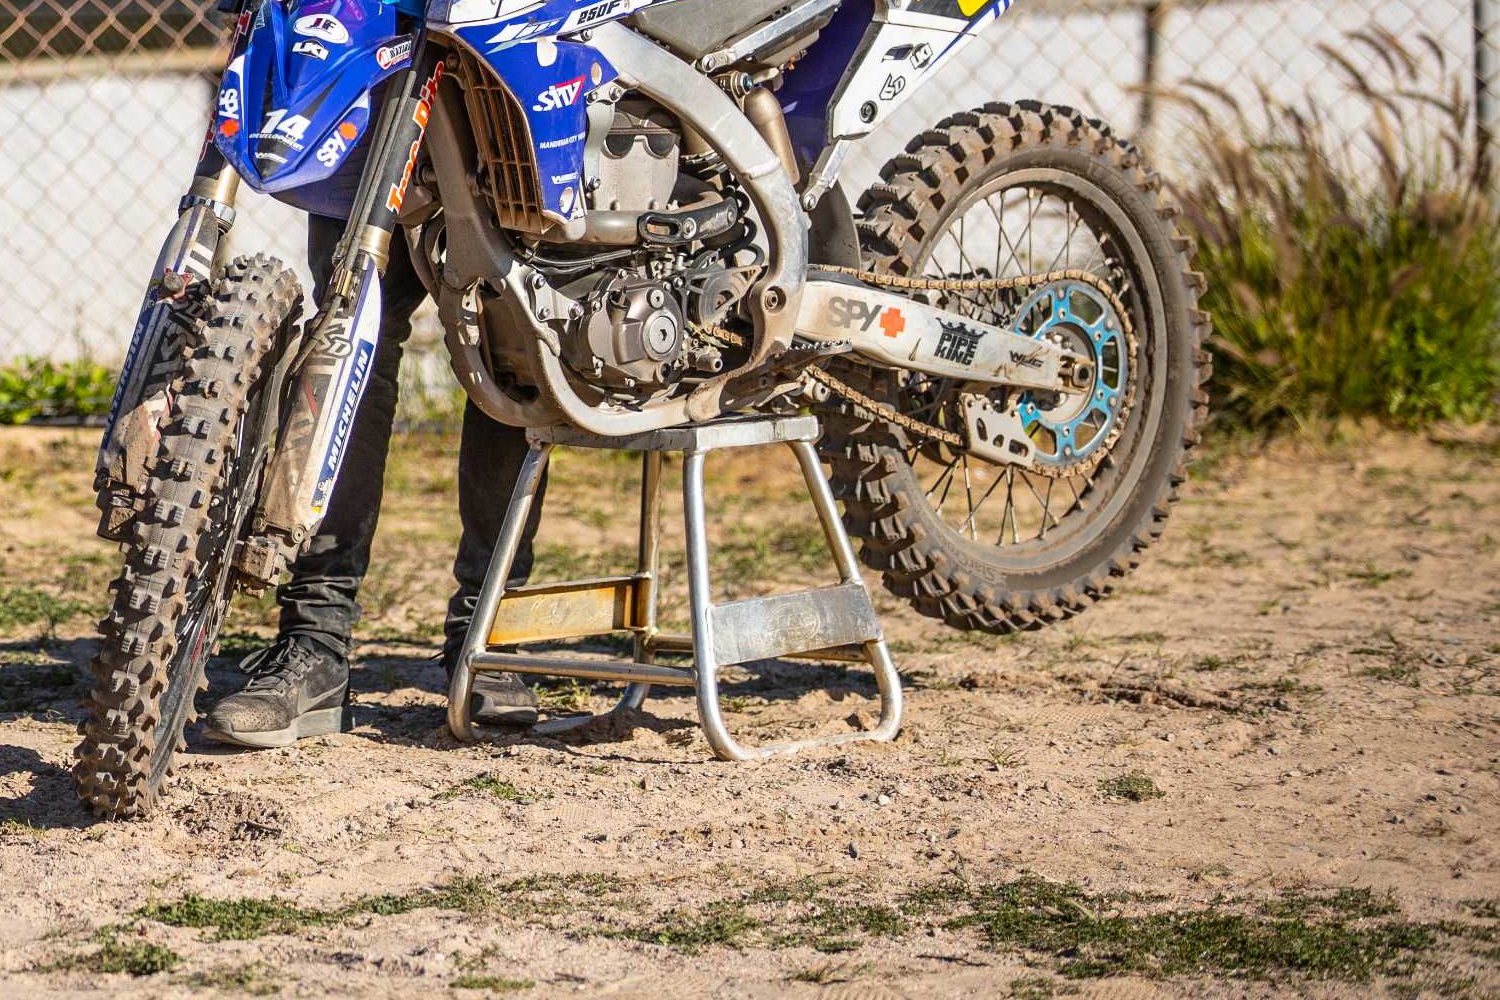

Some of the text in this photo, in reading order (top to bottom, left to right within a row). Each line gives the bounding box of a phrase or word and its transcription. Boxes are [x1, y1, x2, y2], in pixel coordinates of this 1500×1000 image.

[309, 17, 337, 33] JF
[260, 108, 311, 141] 14
[249, 132, 304, 152] DEVELOPMENT
[316, 129, 348, 168] SPY
[827, 296, 883, 332] SPY
[934, 345, 976, 366] KING
[939, 333, 978, 357] PIPE
[327, 348, 369, 472] MICHELIN
